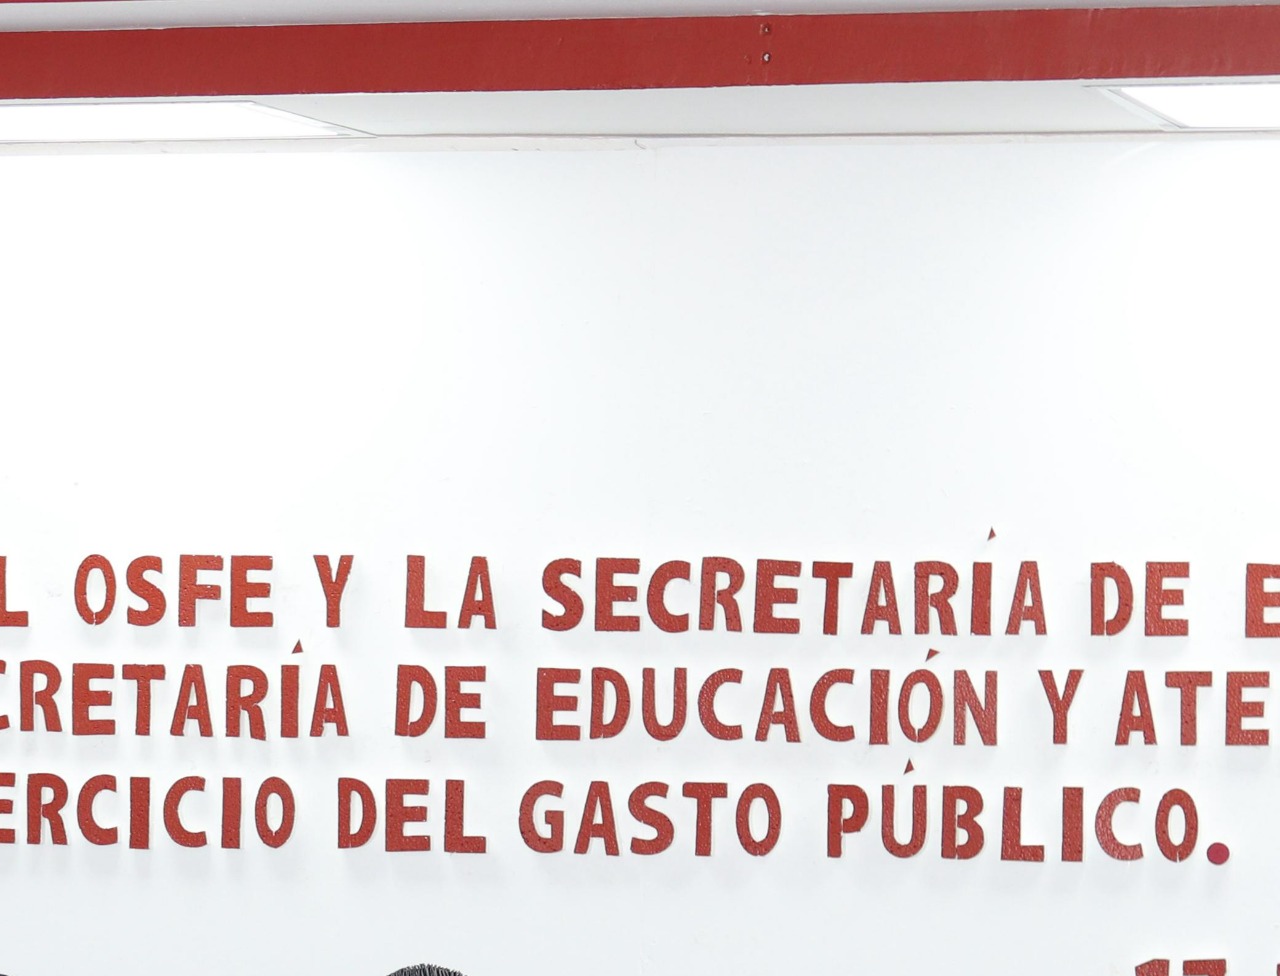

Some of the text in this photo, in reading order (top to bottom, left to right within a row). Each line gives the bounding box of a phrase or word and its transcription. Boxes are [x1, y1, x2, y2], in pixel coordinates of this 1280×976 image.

[74, 554, 273, 628] OSFE
[314, 554, 354, 628] Y
[405, 555, 496, 629] LA
[543, 527, 1047, 636] SECRETARÍA
[1091, 561, 1190, 637] DE
[395, 664, 487, 739] DE
[536, 648, 998, 746] EDUCACIÓN
[1040, 669, 1084, 745] Y
[338, 777, 486, 853] DEL
[519, 780, 782, 856] GASTO
[828, 759, 1230, 865] PÚBLICO.
